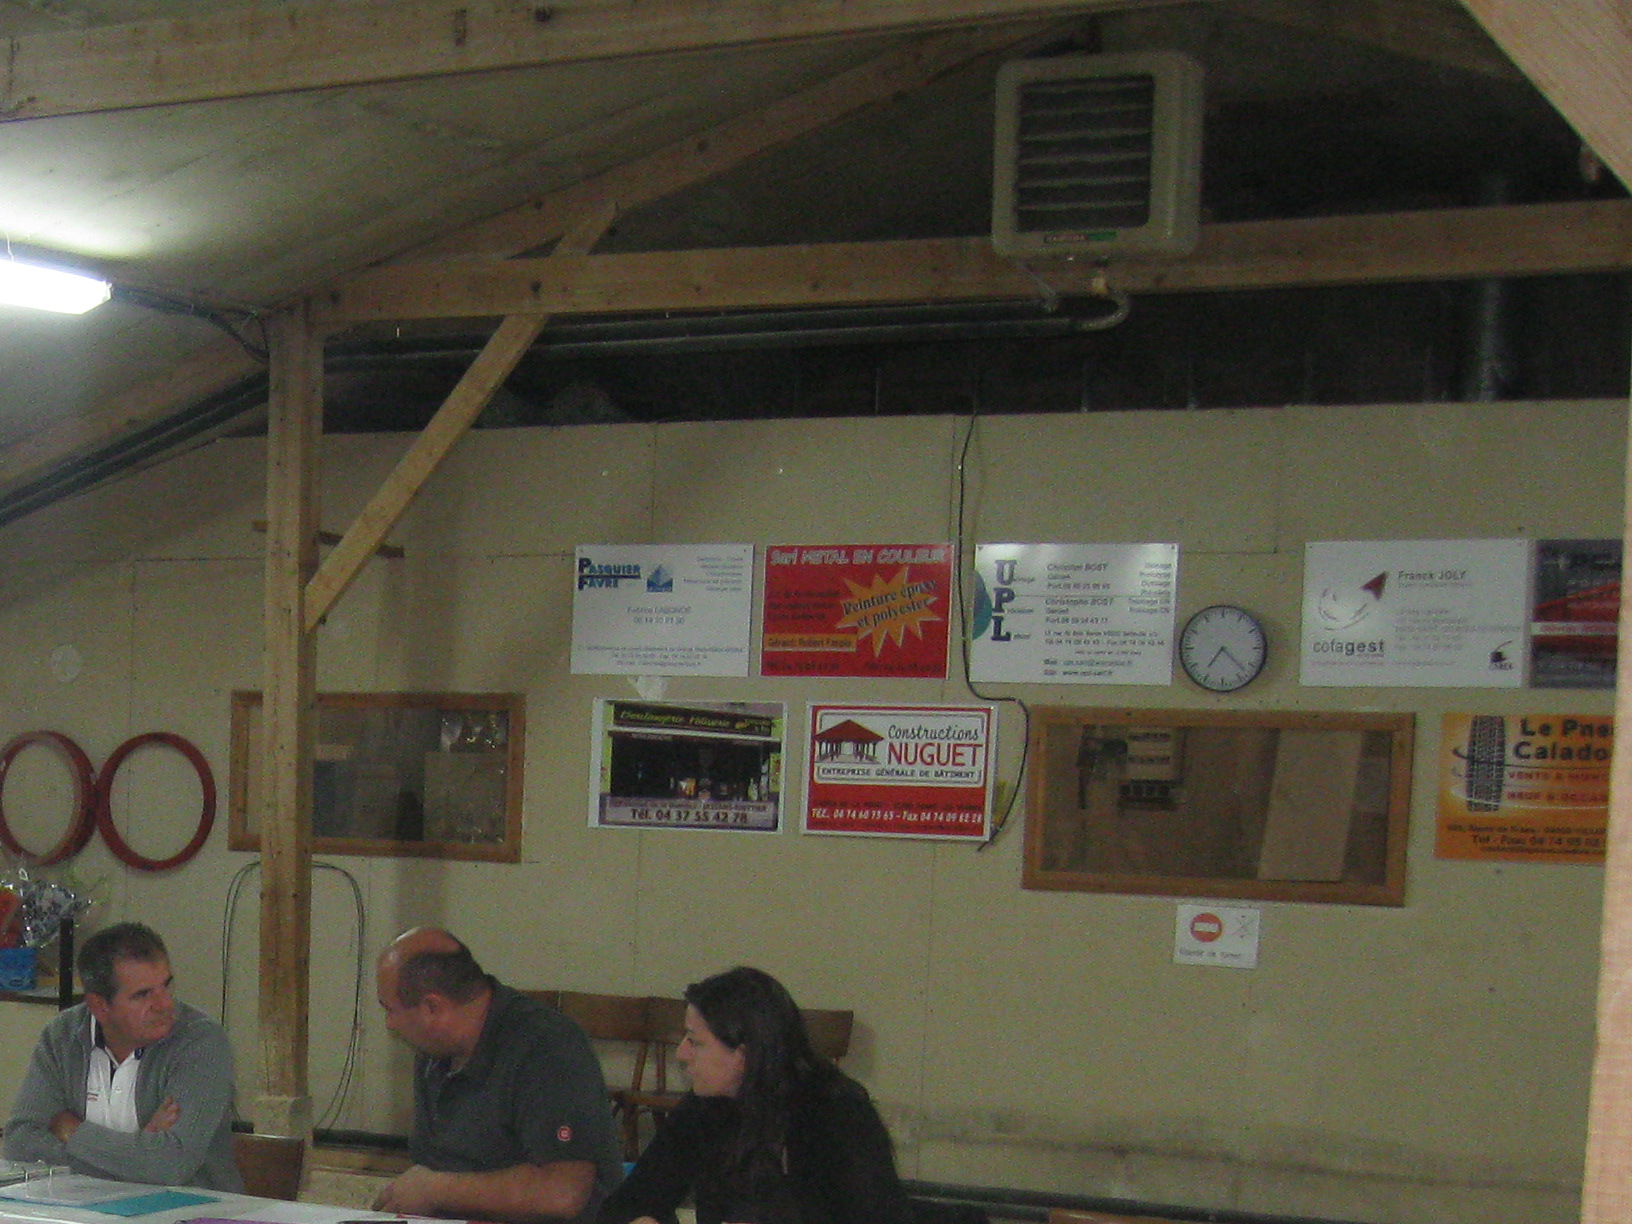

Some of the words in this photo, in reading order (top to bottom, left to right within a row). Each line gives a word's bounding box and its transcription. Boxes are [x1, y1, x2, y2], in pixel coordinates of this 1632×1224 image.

[577, 557, 642, 576] PASQUIER
[1437, 569, 1467, 582] JOLY
[577, 577, 620, 592] FAVRE
[842, 591, 898, 617] Peinture
[856, 614, 872, 628] et
[872, 597, 930, 627] polyester
[1312, 638, 1386, 656] cofagest
[887, 724, 980, 741] Constructions
[1520, 718, 1553, 737] Le
[1561, 718, 1614, 738] Pne
[887, 742, 983, 768] NUGUET
[1512, 741, 1610, 761] Calado
[821, 767, 871, 777] ENTREPRISE
[919, 769, 930, 778] DE
[655, 809, 671, 822] 04
[675, 810, 690, 822] 37
[694, 811, 710, 823] 55
[713, 811, 729, 824] 42
[732, 812, 749, 824] 78
